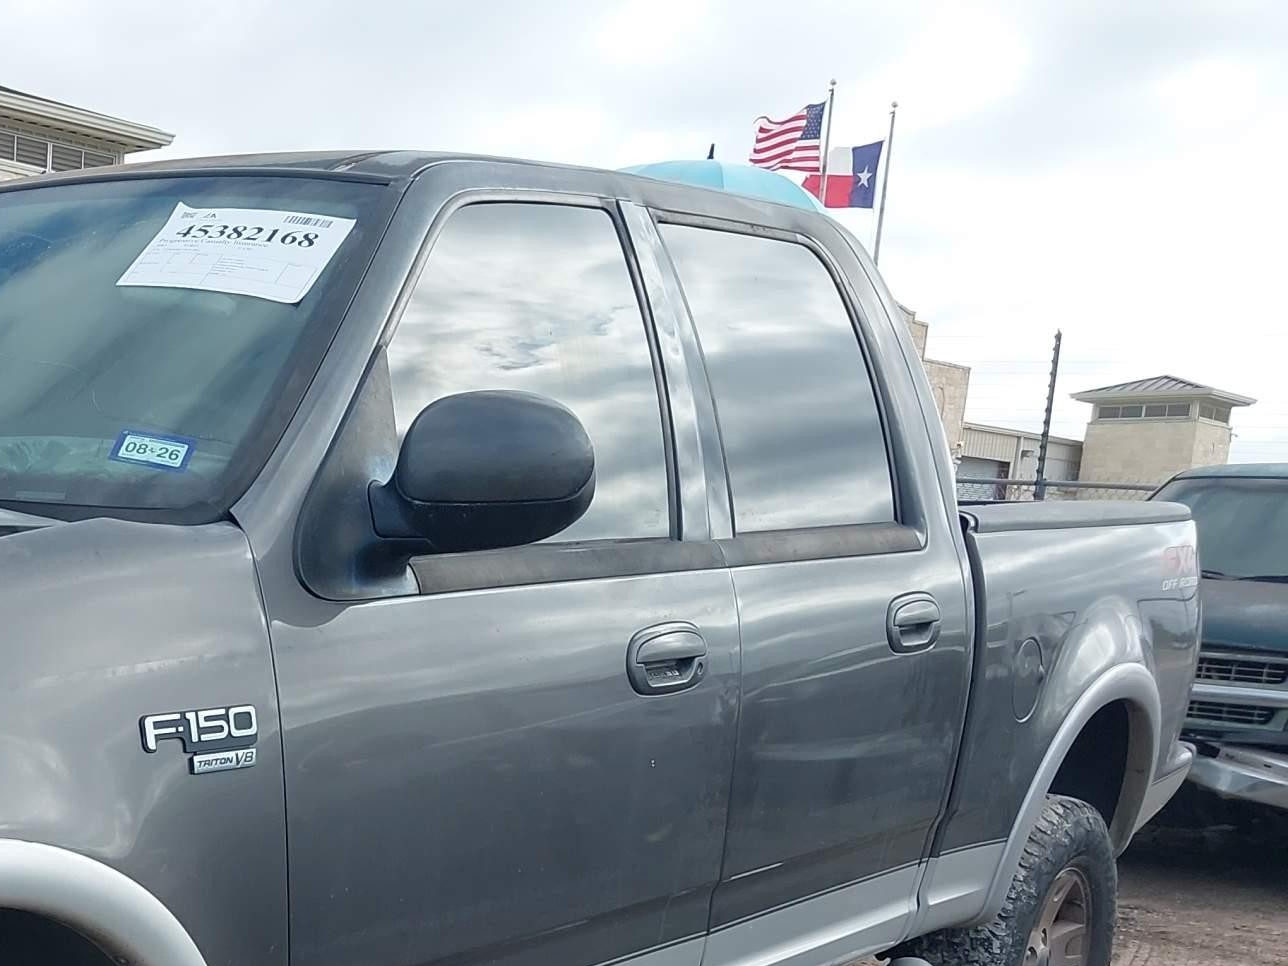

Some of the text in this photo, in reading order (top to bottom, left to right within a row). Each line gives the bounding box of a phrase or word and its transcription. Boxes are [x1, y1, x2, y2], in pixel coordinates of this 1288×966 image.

[176, 224, 320, 248] 45382168
[197, 751, 255, 769] TRITON V8
